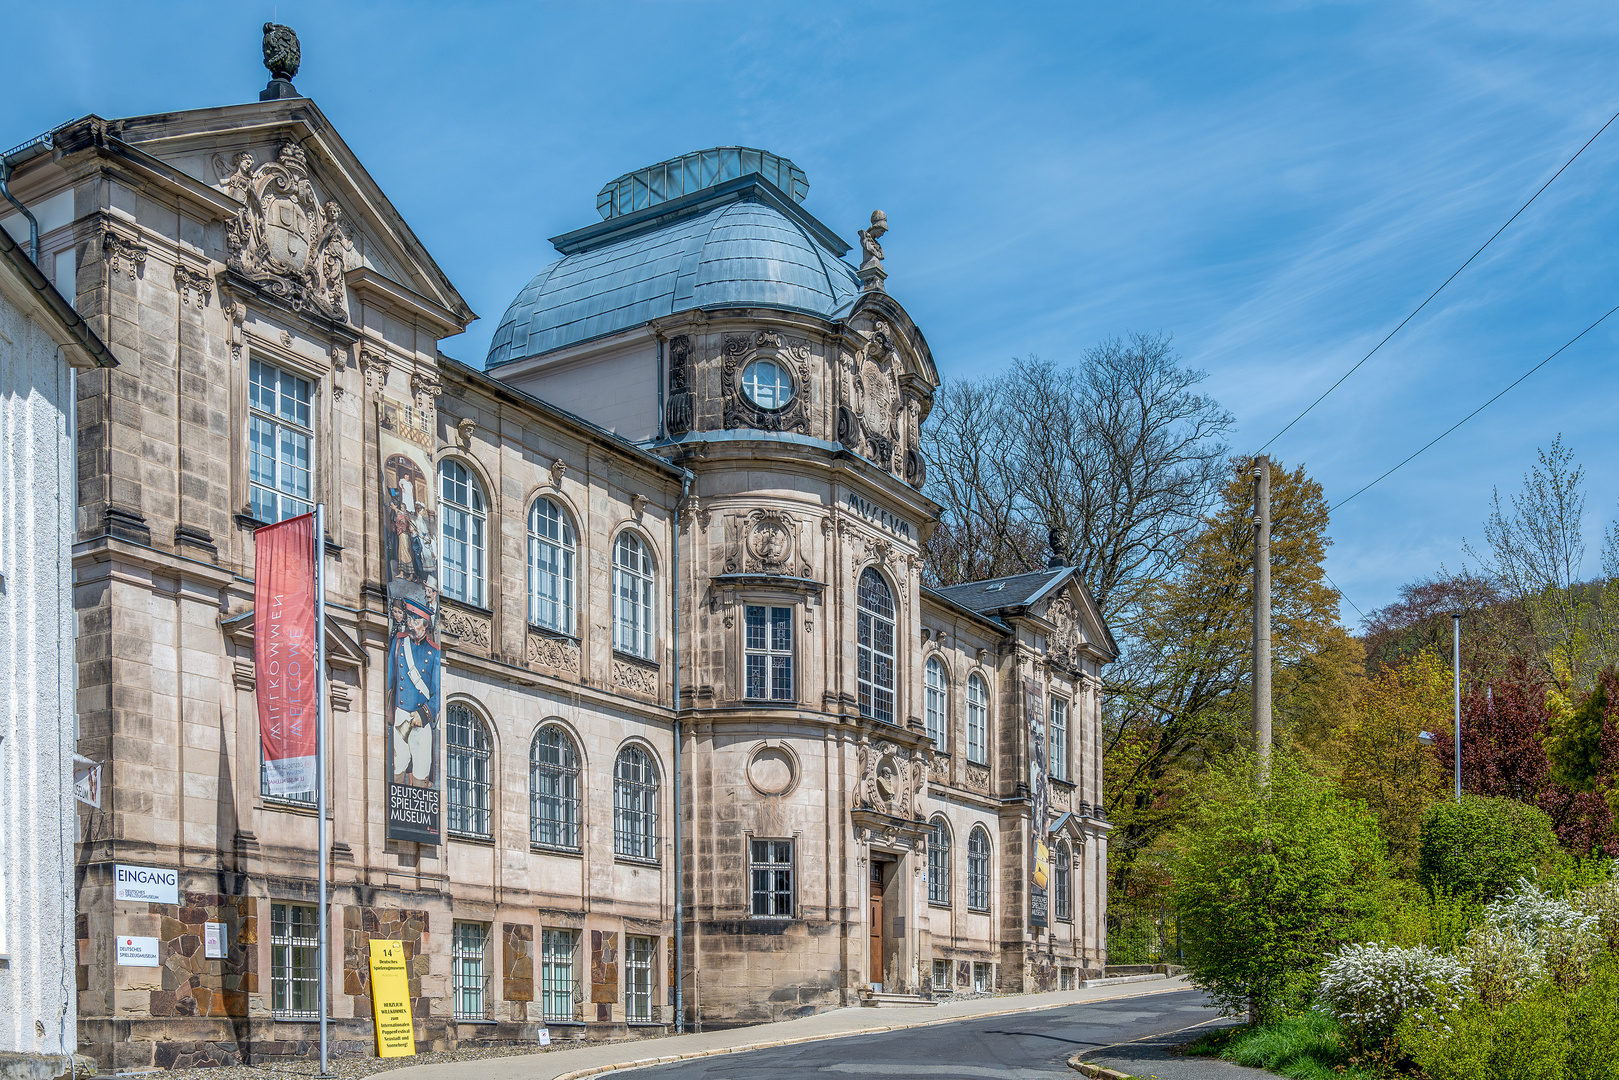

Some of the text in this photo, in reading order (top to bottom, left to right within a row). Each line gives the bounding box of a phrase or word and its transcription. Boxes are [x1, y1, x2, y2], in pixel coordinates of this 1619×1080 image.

[391, 785, 438, 802] DEUTSCHES
[391, 797, 438, 814] SPIELZEUG
[391, 809, 431, 825] MUSEUM
[118, 870, 176, 886] EINGANG
